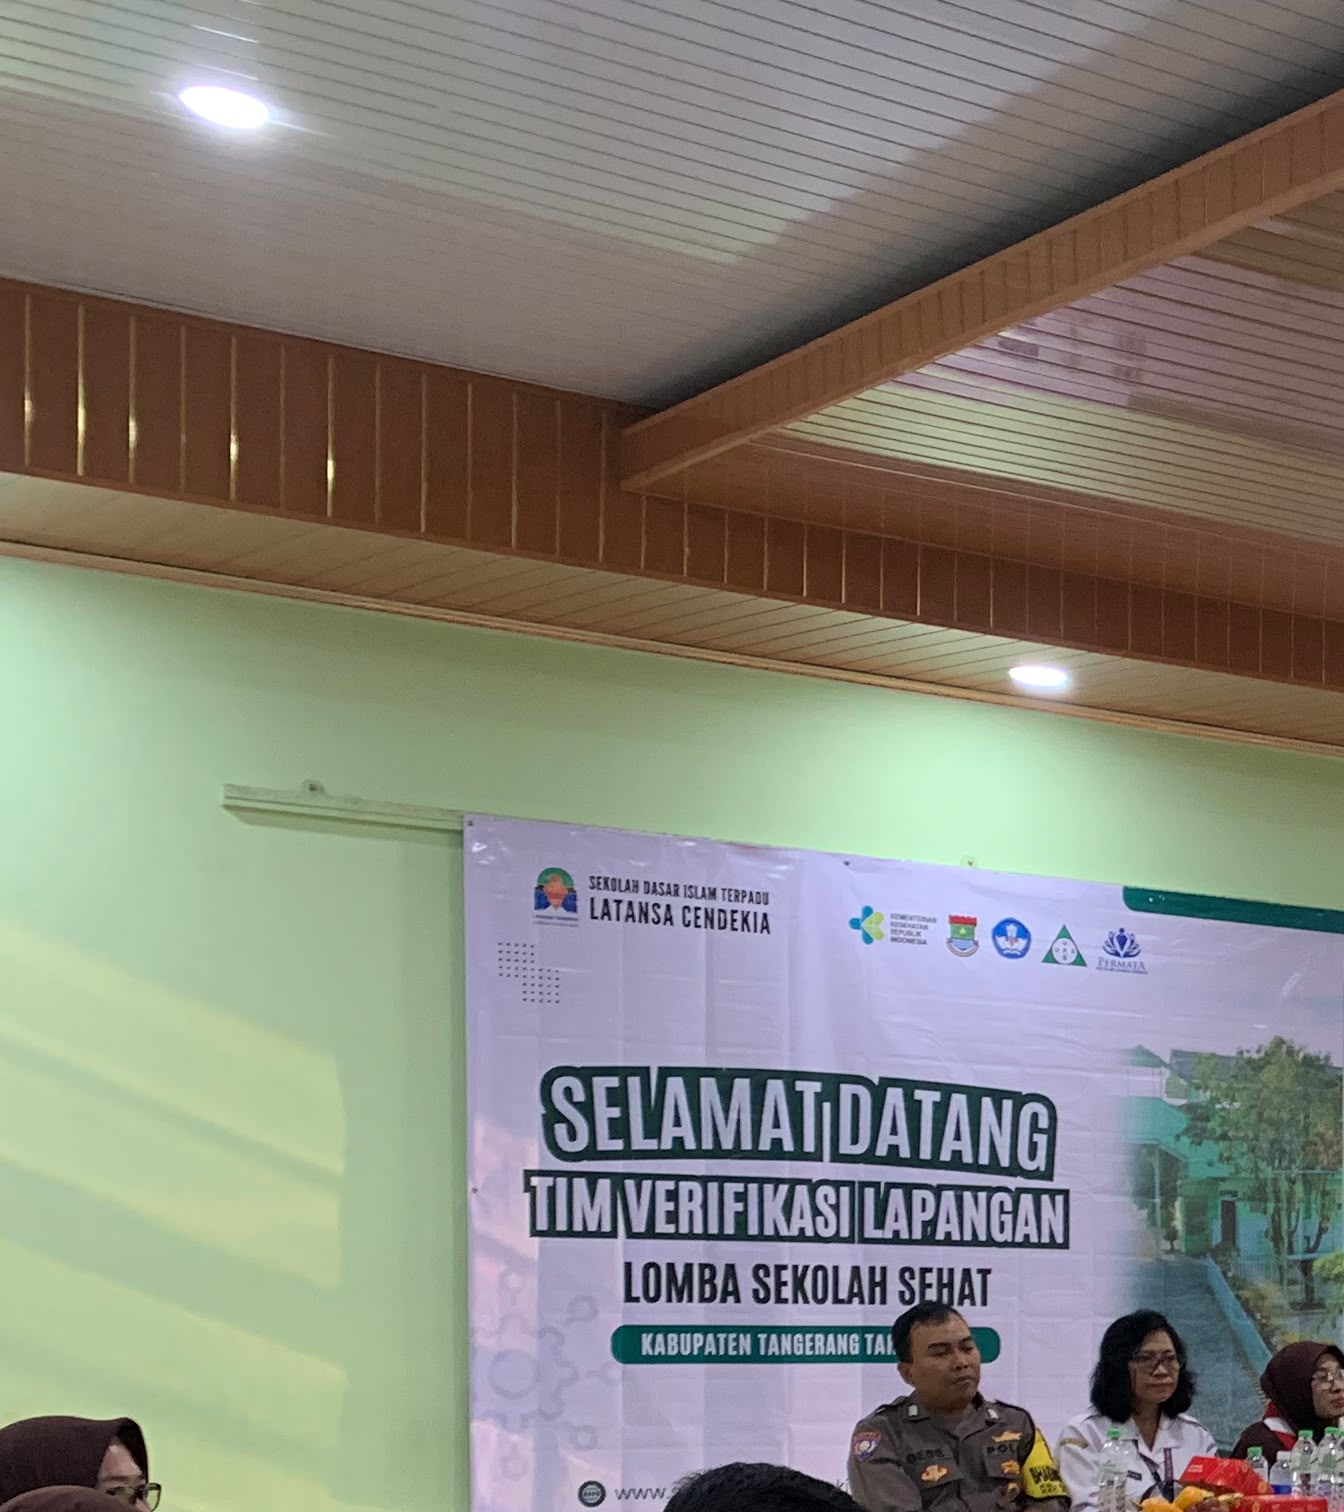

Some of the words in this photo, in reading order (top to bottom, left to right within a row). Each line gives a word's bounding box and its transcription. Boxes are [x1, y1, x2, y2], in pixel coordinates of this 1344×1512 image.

[589, 875, 640, 894] SEKOLAH
[643, 880, 681, 898] DASAR
[683, 883, 717, 901] ISLAM
[721, 887, 770, 906] TERPADU
[589, 897, 675, 927] LATANSA
[681, 906, 772, 935] CENDEKIA
[1098, 956, 1147, 971] PERMATA
[549, 1074, 822, 1154] SELAMAT
[837, 1082, 1050, 1173] DATANG
[529, 1176, 613, 1233] TIM
[623, 1178, 851, 1238] VERIFIKASI
[864, 1186, 1066, 1244] LAPANGAN
[623, 1261, 742, 1304] LOMBA
[751, 1262, 888, 1306] SEKOLAH
[898, 1266, 992, 1307] SEHAT
[640, 1332, 752, 1356] KABUPATEN
[757, 1332, 860, 1357] TANGERANG
